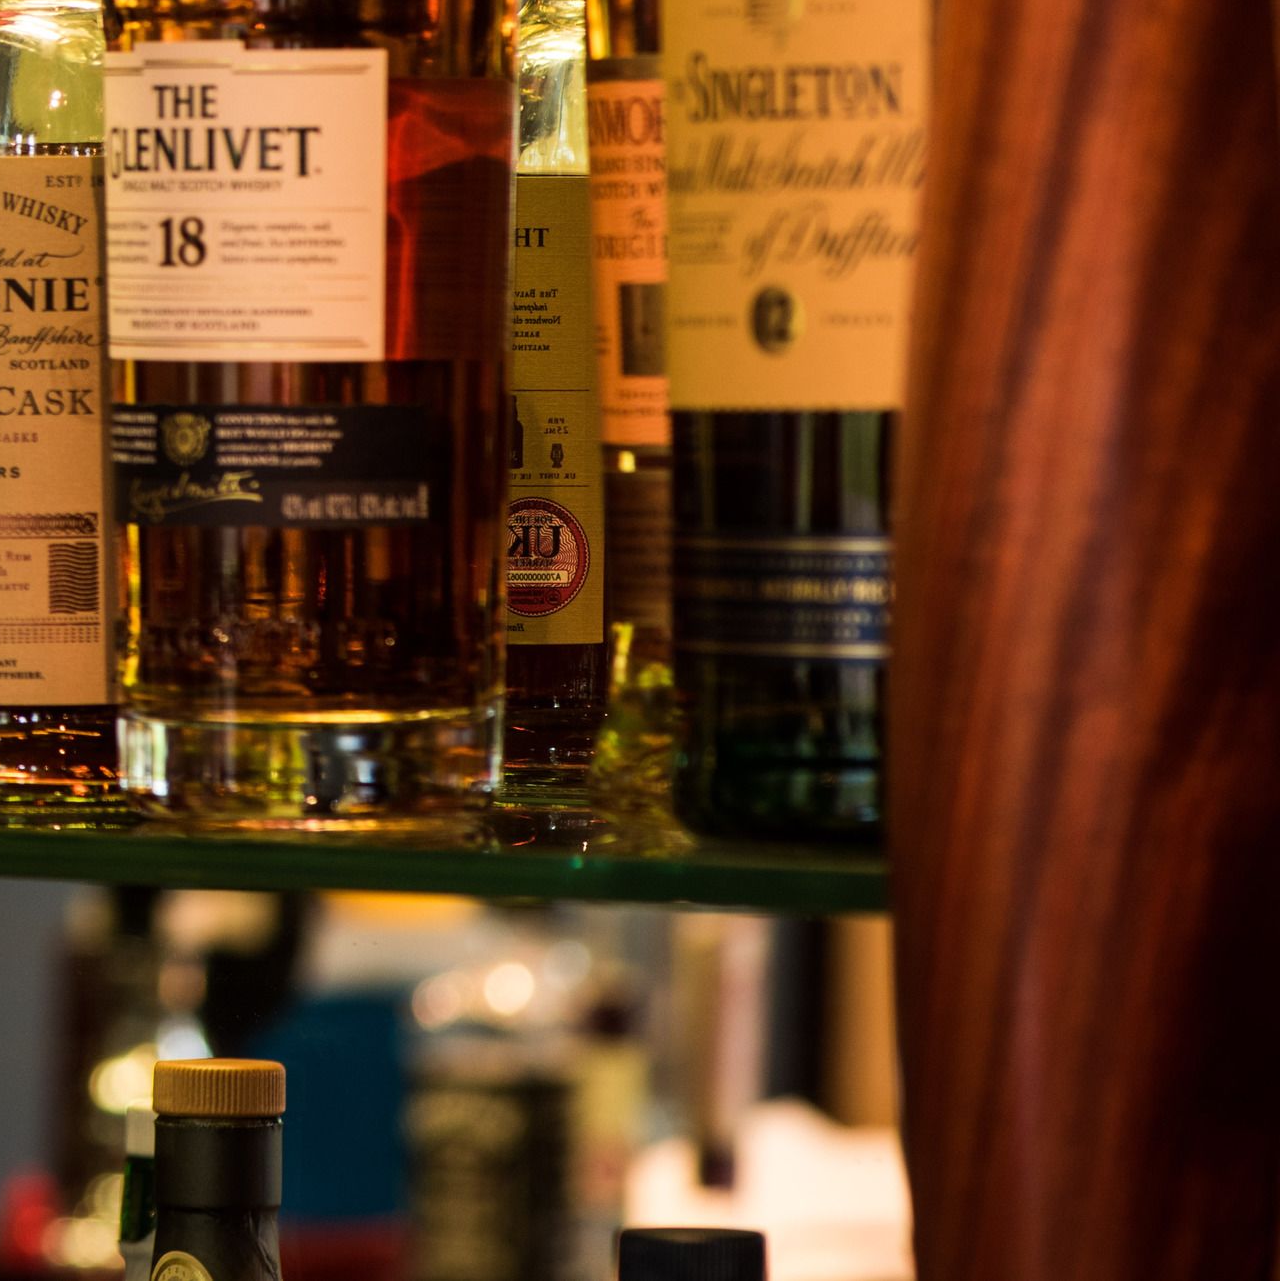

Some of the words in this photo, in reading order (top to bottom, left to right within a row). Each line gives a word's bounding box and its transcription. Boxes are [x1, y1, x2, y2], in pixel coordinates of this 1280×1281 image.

[152, 83, 219, 120] THE
[686, 49, 904, 123] SINGLETON
[110, 126, 323, 180] GLENLIVET
[178, 179, 225, 193] SCOTCH
[230, 179, 284, 193] WHISKY
[2, 190, 89, 236] WHISKY
[158, 215, 208, 268] 18
[9, 358, 90, 370] SCOTLAND
